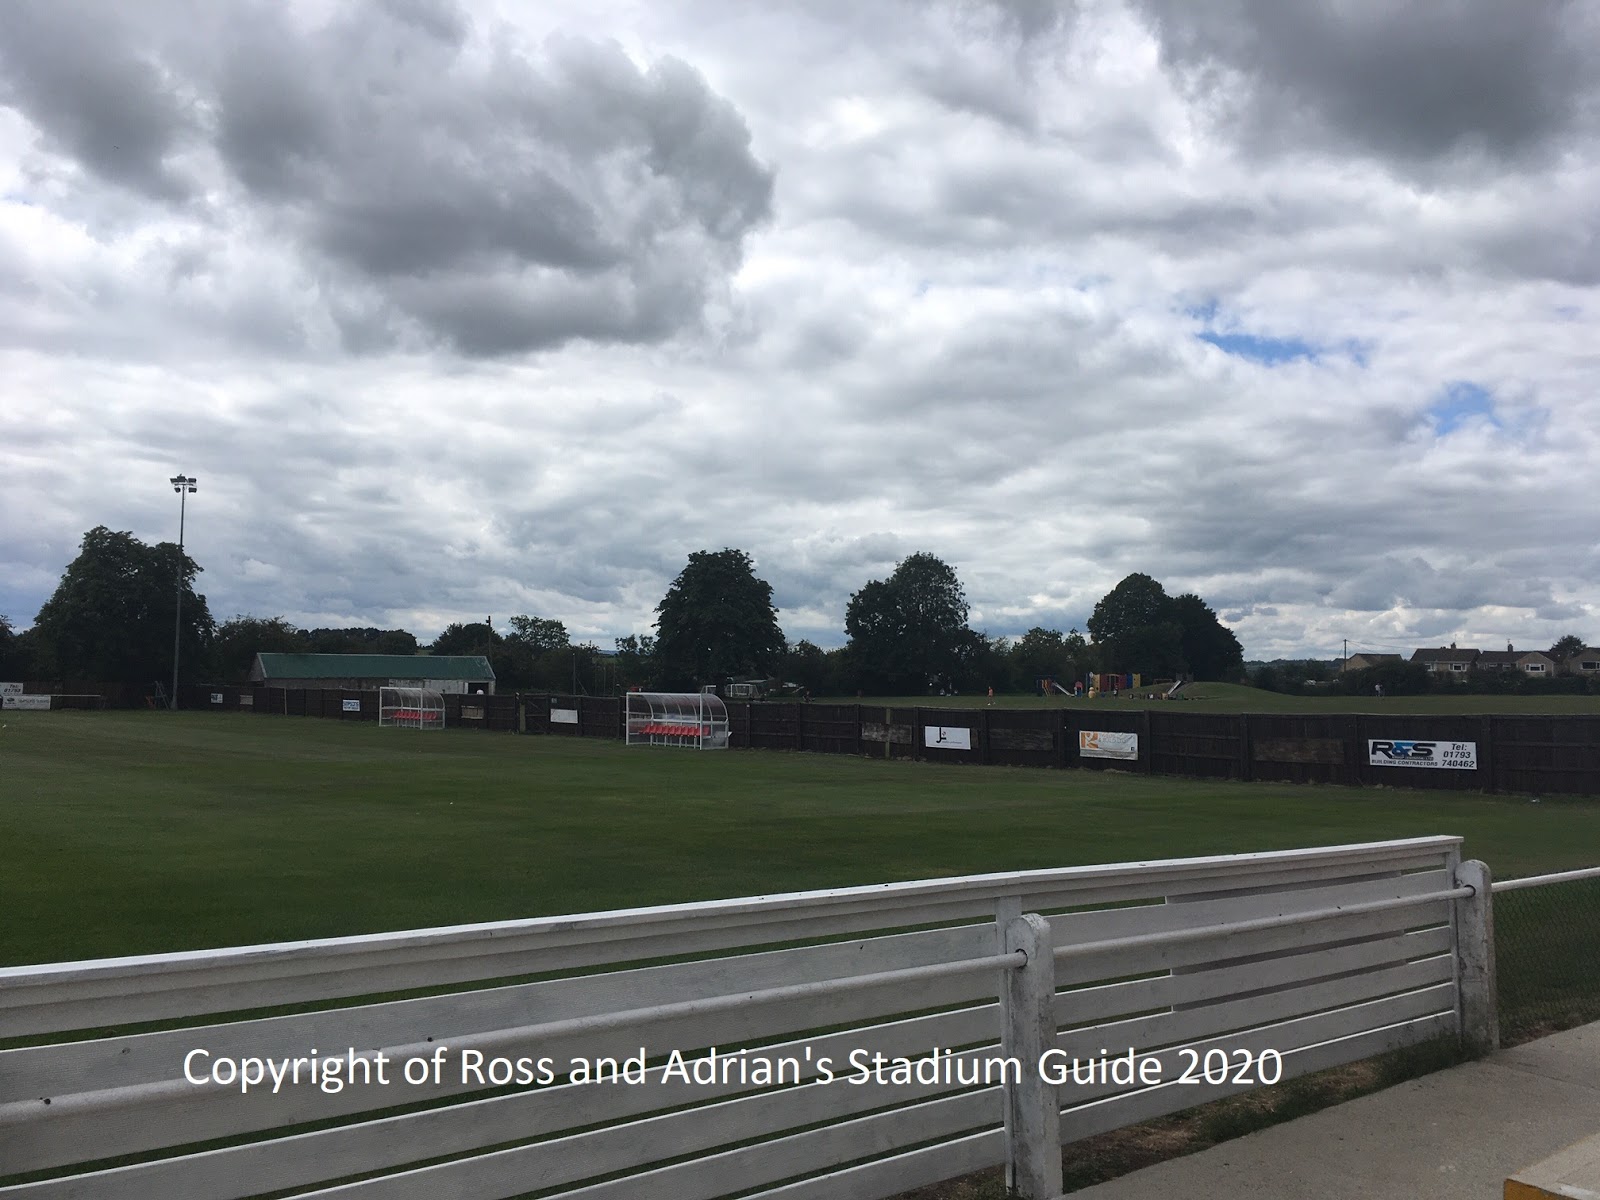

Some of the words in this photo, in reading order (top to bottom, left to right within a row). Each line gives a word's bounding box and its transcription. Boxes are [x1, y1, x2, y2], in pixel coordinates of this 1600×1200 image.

[1370, 741, 1437, 760] R&S
[1451, 743, 1468, 751] Tel:
[1443, 750, 1472, 759] 01793
[1441, 759, 1475, 768] 740462
